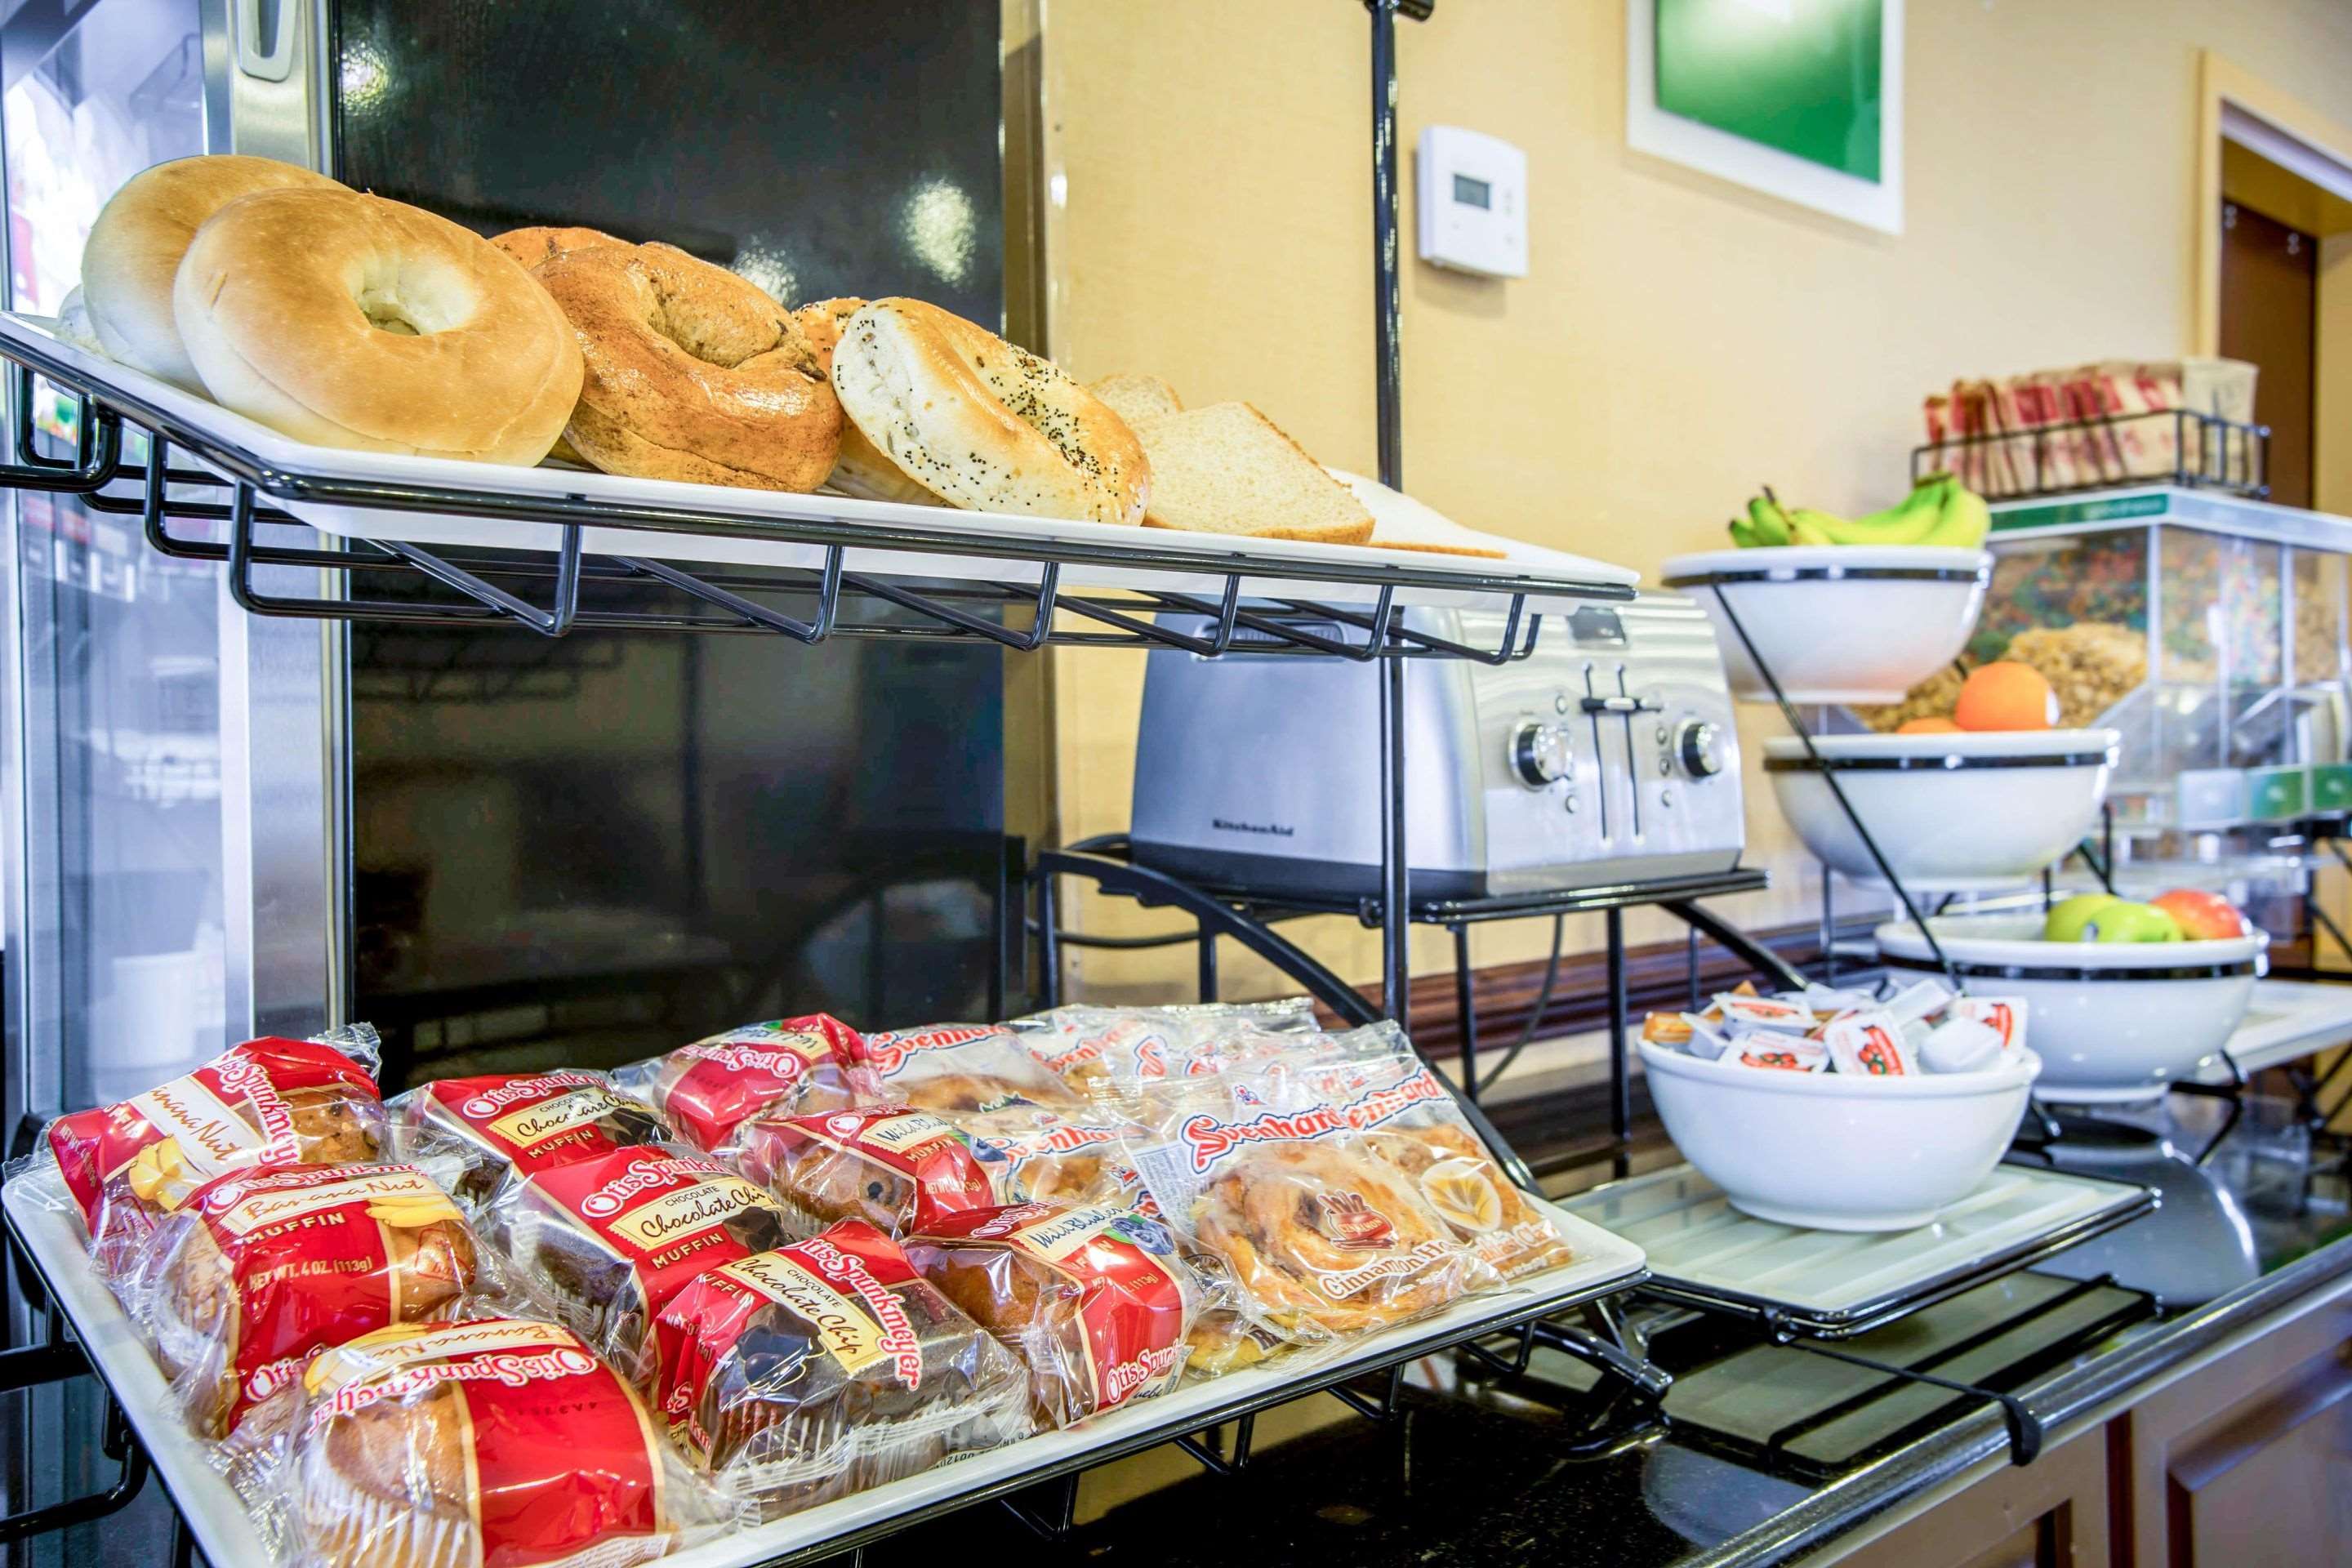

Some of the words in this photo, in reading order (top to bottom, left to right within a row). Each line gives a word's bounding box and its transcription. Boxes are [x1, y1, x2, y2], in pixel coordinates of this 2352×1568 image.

[1212, 819, 1293, 836] KitchenAid
[870, 1024, 1013, 1077] Svenhar
[150, 1086, 200, 1130] anana
[528, 1130, 595, 1160] MUFFIN
[1182, 1107, 1343, 1174] Svenhard
[365, 1178, 424, 1194] Nut
[665, 1185, 721, 1208] CHOCOLATE
[246, 1211, 346, 1245] MUFFIN
[640, 1196, 738, 1238] Chocolate
[650, 1232, 724, 1270] MUFFIN
[786, 1269, 841, 1308] CHOCOLATE
[1320, 1255, 1424, 1300] Cinnamon
[730, 1258, 822, 1316] Chocolate
[817, 1314, 863, 1356] Chip
